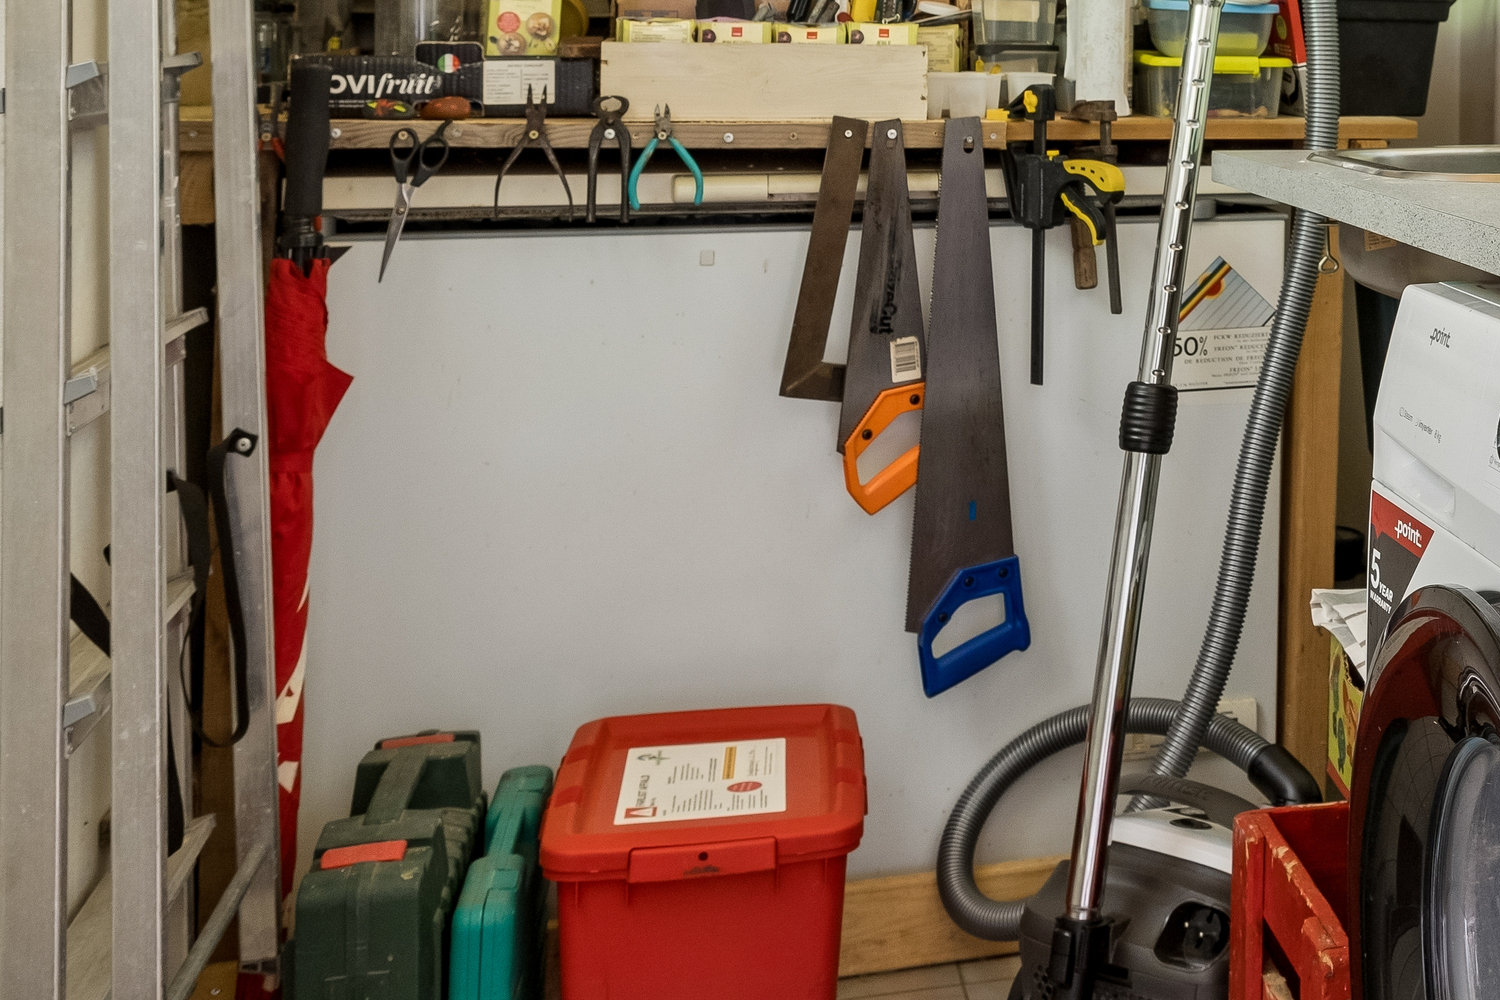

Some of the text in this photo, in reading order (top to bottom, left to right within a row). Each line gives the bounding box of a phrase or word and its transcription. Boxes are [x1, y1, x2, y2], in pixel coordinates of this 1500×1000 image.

[329, 73, 442, 98] OVIfruit
[1429, 327, 1451, 348] point
[1394, 519, 1422, 549] point
[1370, 547, 1394, 603] 5 YEAR
